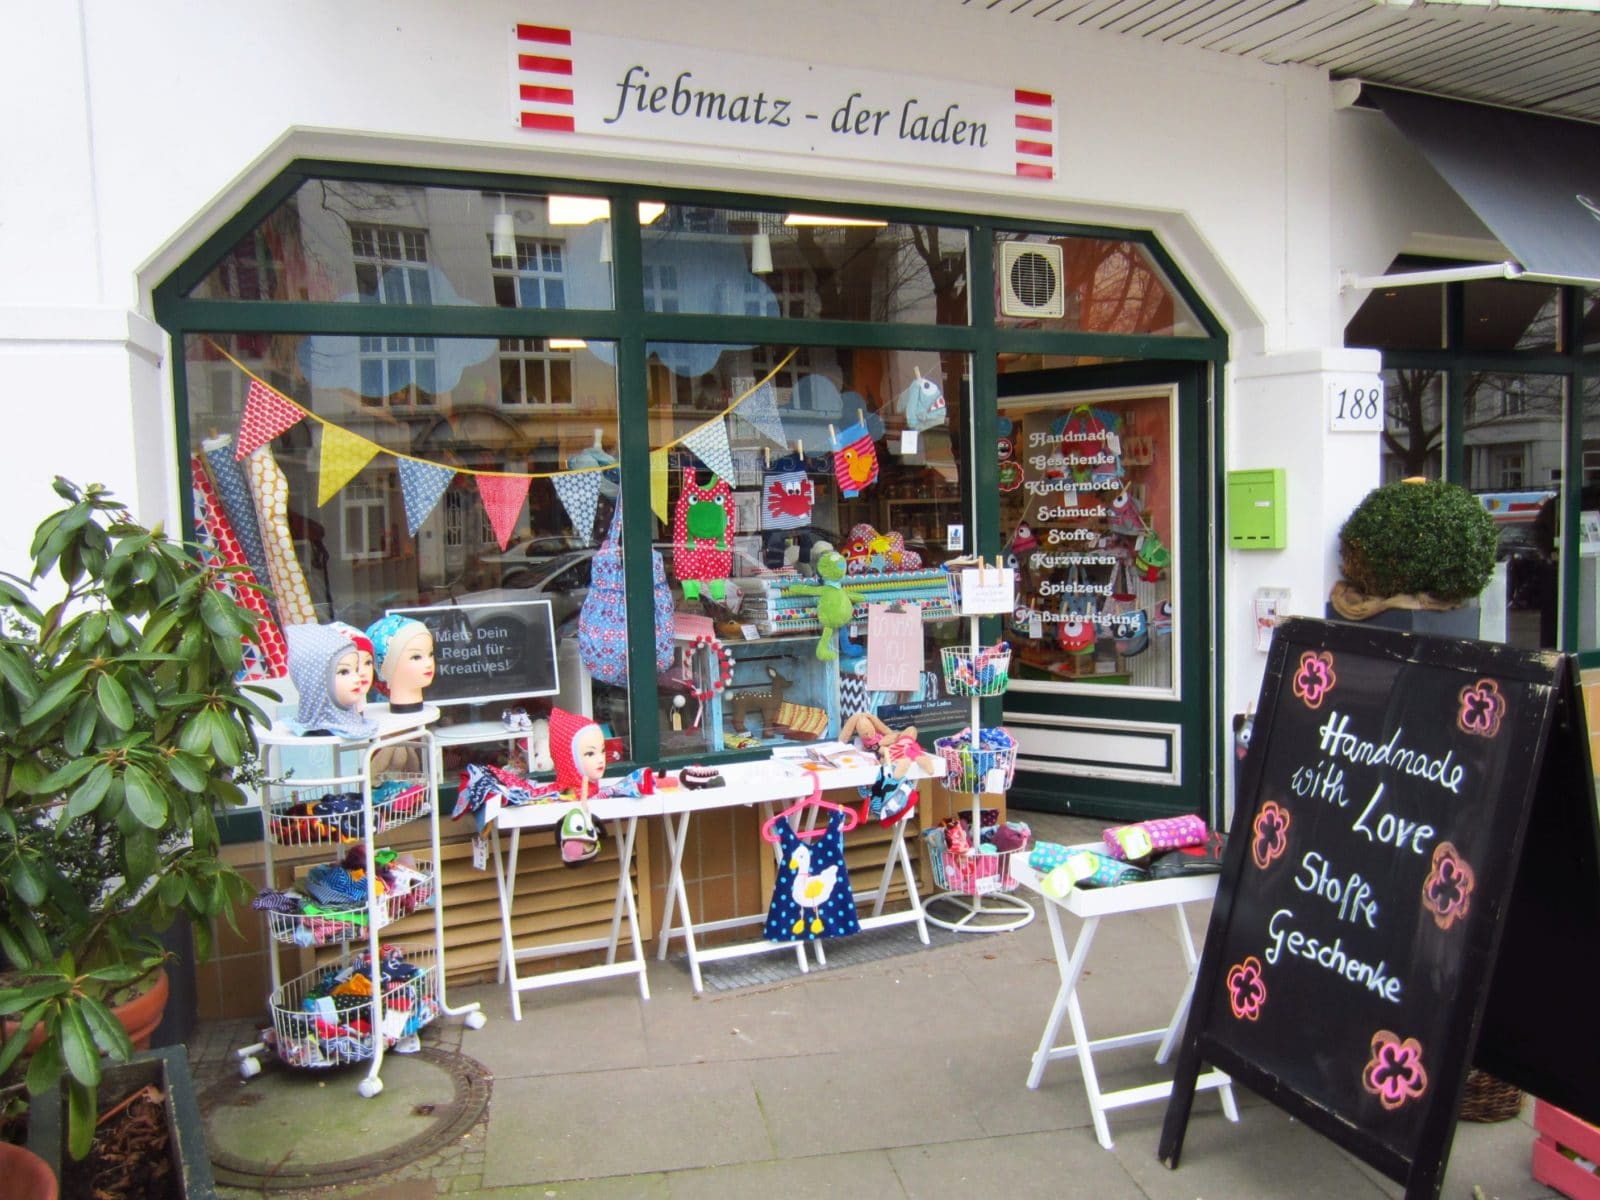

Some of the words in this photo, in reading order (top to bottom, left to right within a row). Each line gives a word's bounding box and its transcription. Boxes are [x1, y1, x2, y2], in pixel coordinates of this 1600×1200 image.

[603, 65, 791, 128] fiebmatz
[831, 93, 889, 137] der
[898, 99, 988, 148] laden
[1335, 388, 1380, 420] 188
[1029, 431, 1115, 446] Handmade
[1029, 454, 1115, 470] Geschenke
[1024, 480, 1120, 496] Kindermode
[1037, 505, 1107, 521] Schmuck
[1047, 529, 1095, 544] Stoffe
[1030, 553, 1116, 569] Kurzwaren
[1039, 581, 1114, 597] Spielzeug
[1015, 608, 1141, 627] Maßanfertigung
[435, 630, 472, 642] Miete
[477, 627, 508, 640] Dein
[442, 644, 481, 660] Regal
[485, 642, 505, 656] für
[439, 659, 510, 675] Kreatives!
[1319, 711, 1465, 793] Handmade
[1291, 760, 1350, 808] with
[1352, 782, 1435, 855] Love
[1294, 851, 1378, 928] Stoffe
[1265, 909, 1401, 1003] Geschenke
